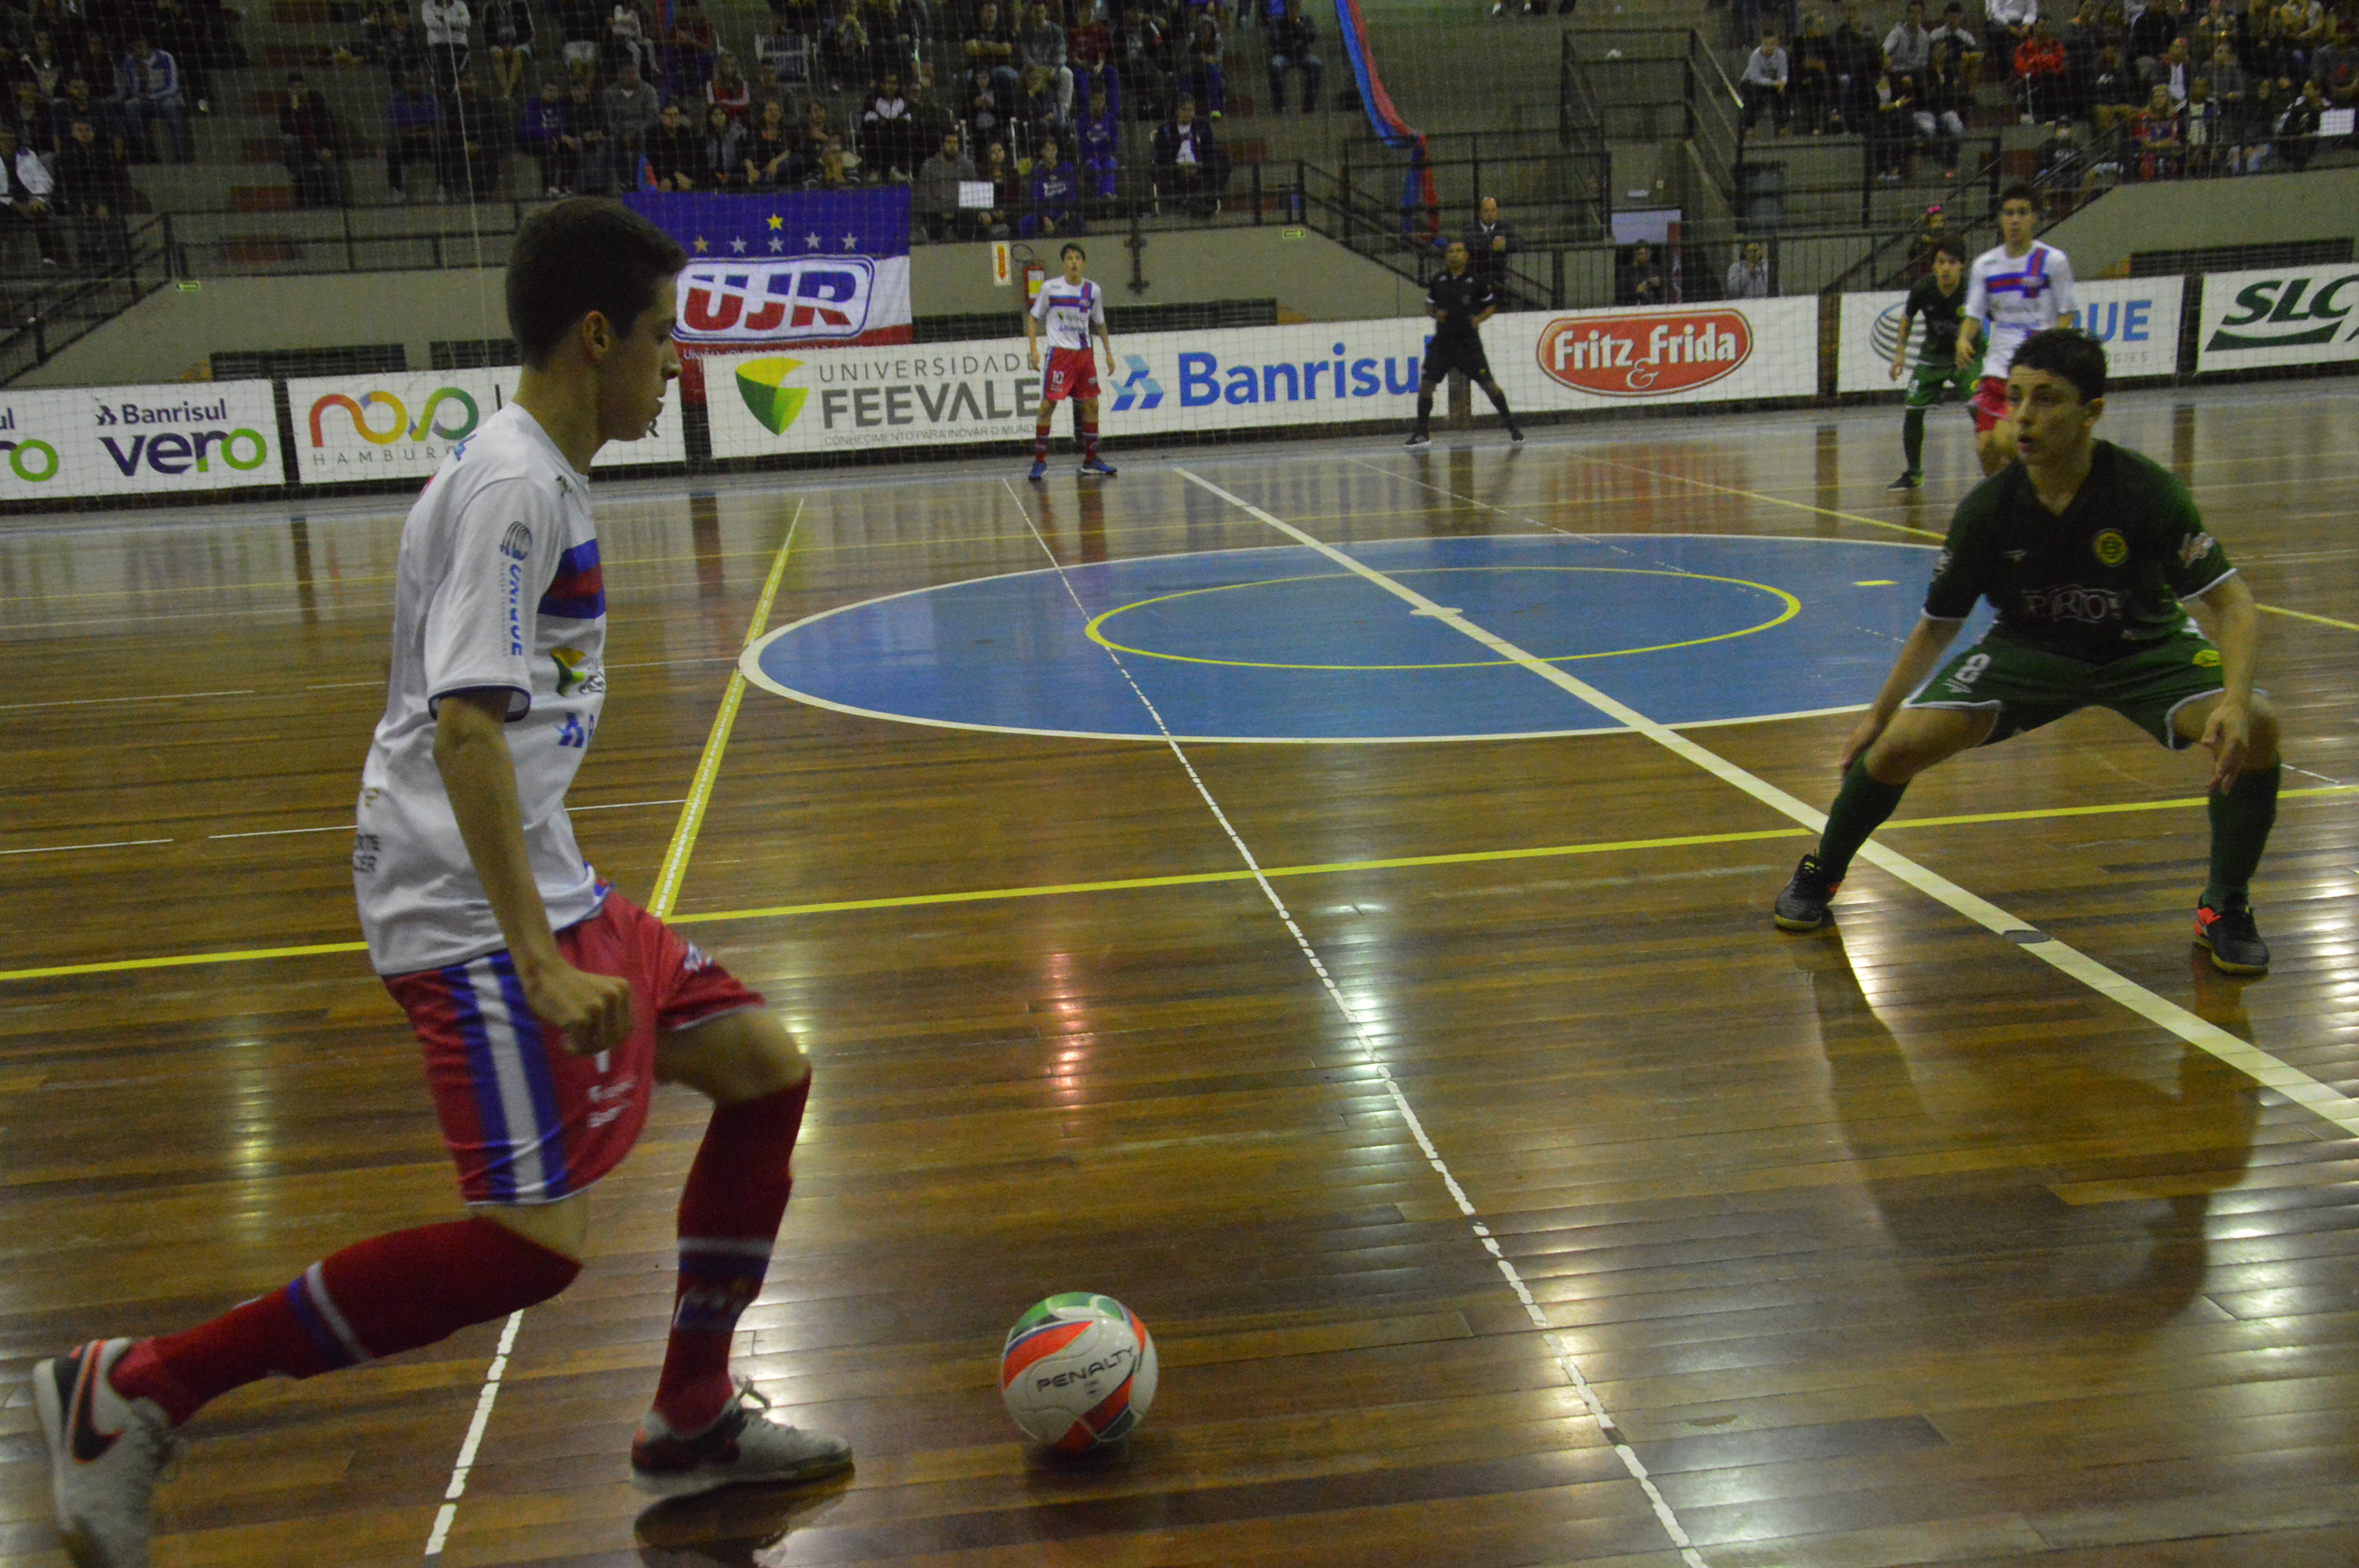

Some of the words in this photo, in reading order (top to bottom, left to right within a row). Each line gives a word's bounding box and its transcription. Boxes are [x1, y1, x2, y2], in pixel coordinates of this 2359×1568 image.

[684, 270, 856, 331] UJR
[2221, 274, 2359, 325] SLC
[1554, 330, 1634, 371] Fritz
[1649, 322, 1737, 365] Frida
[122, 398, 227, 424] Banrisul
[822, 377, 1041, 429] FEEVALE
[98, 427, 267, 477] vero
[824, 430, 914, 446] CONHECIMENTO
[916, 430, 947, 440] PARA
[948, 427, 988, 439] INOVAR
[1001, 424, 1037, 436] MUND
[1036, 1347, 1133, 1392] PENALTY
